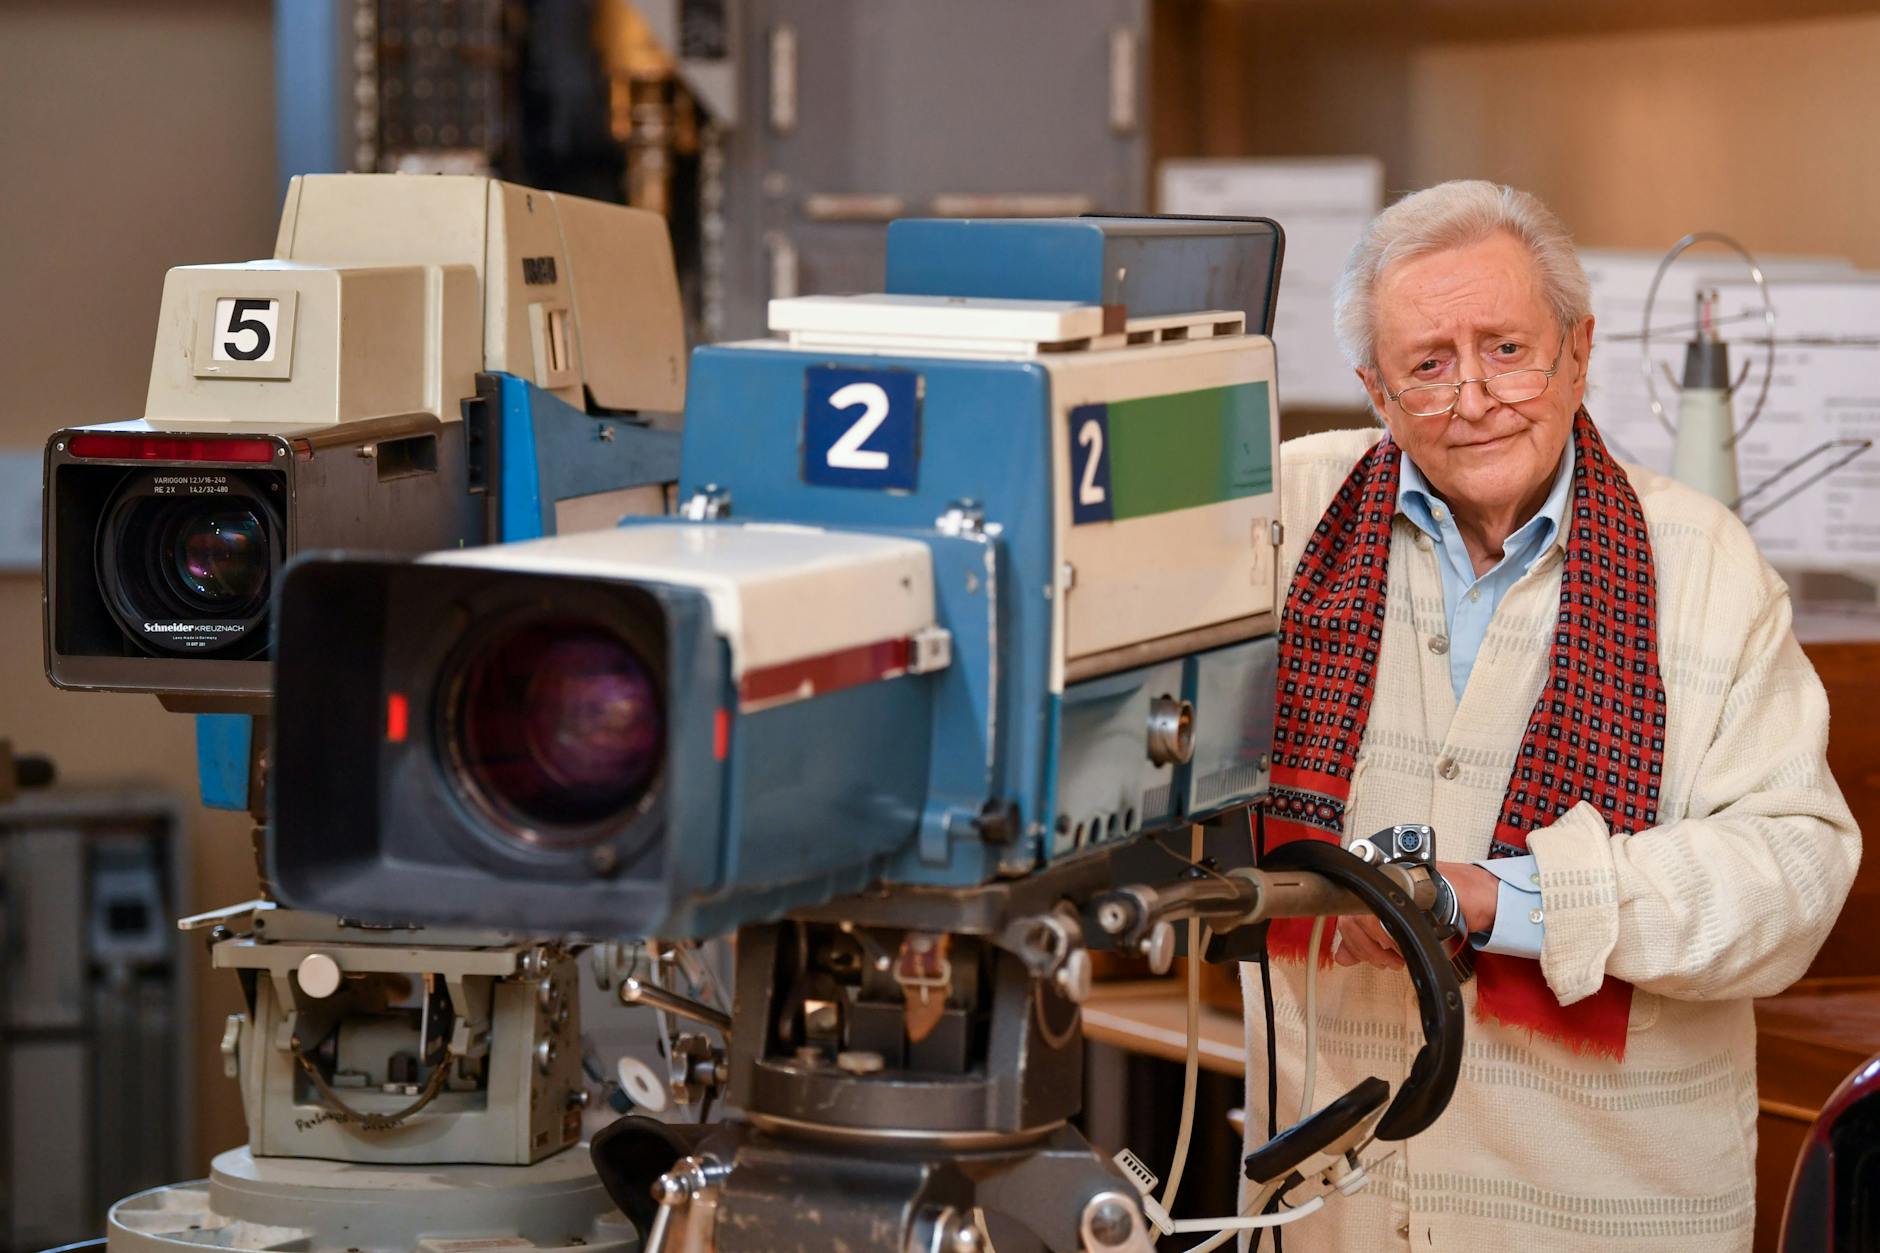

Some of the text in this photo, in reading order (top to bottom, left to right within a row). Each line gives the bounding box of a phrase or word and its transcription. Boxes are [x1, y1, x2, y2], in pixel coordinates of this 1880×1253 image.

[224, 299, 271, 361] 5
[826, 382, 890, 470] 2
[153, 476, 188, 484] VARIOGON
[1079, 420, 1105, 505] 2
[144, 622, 194, 632] Schneider
